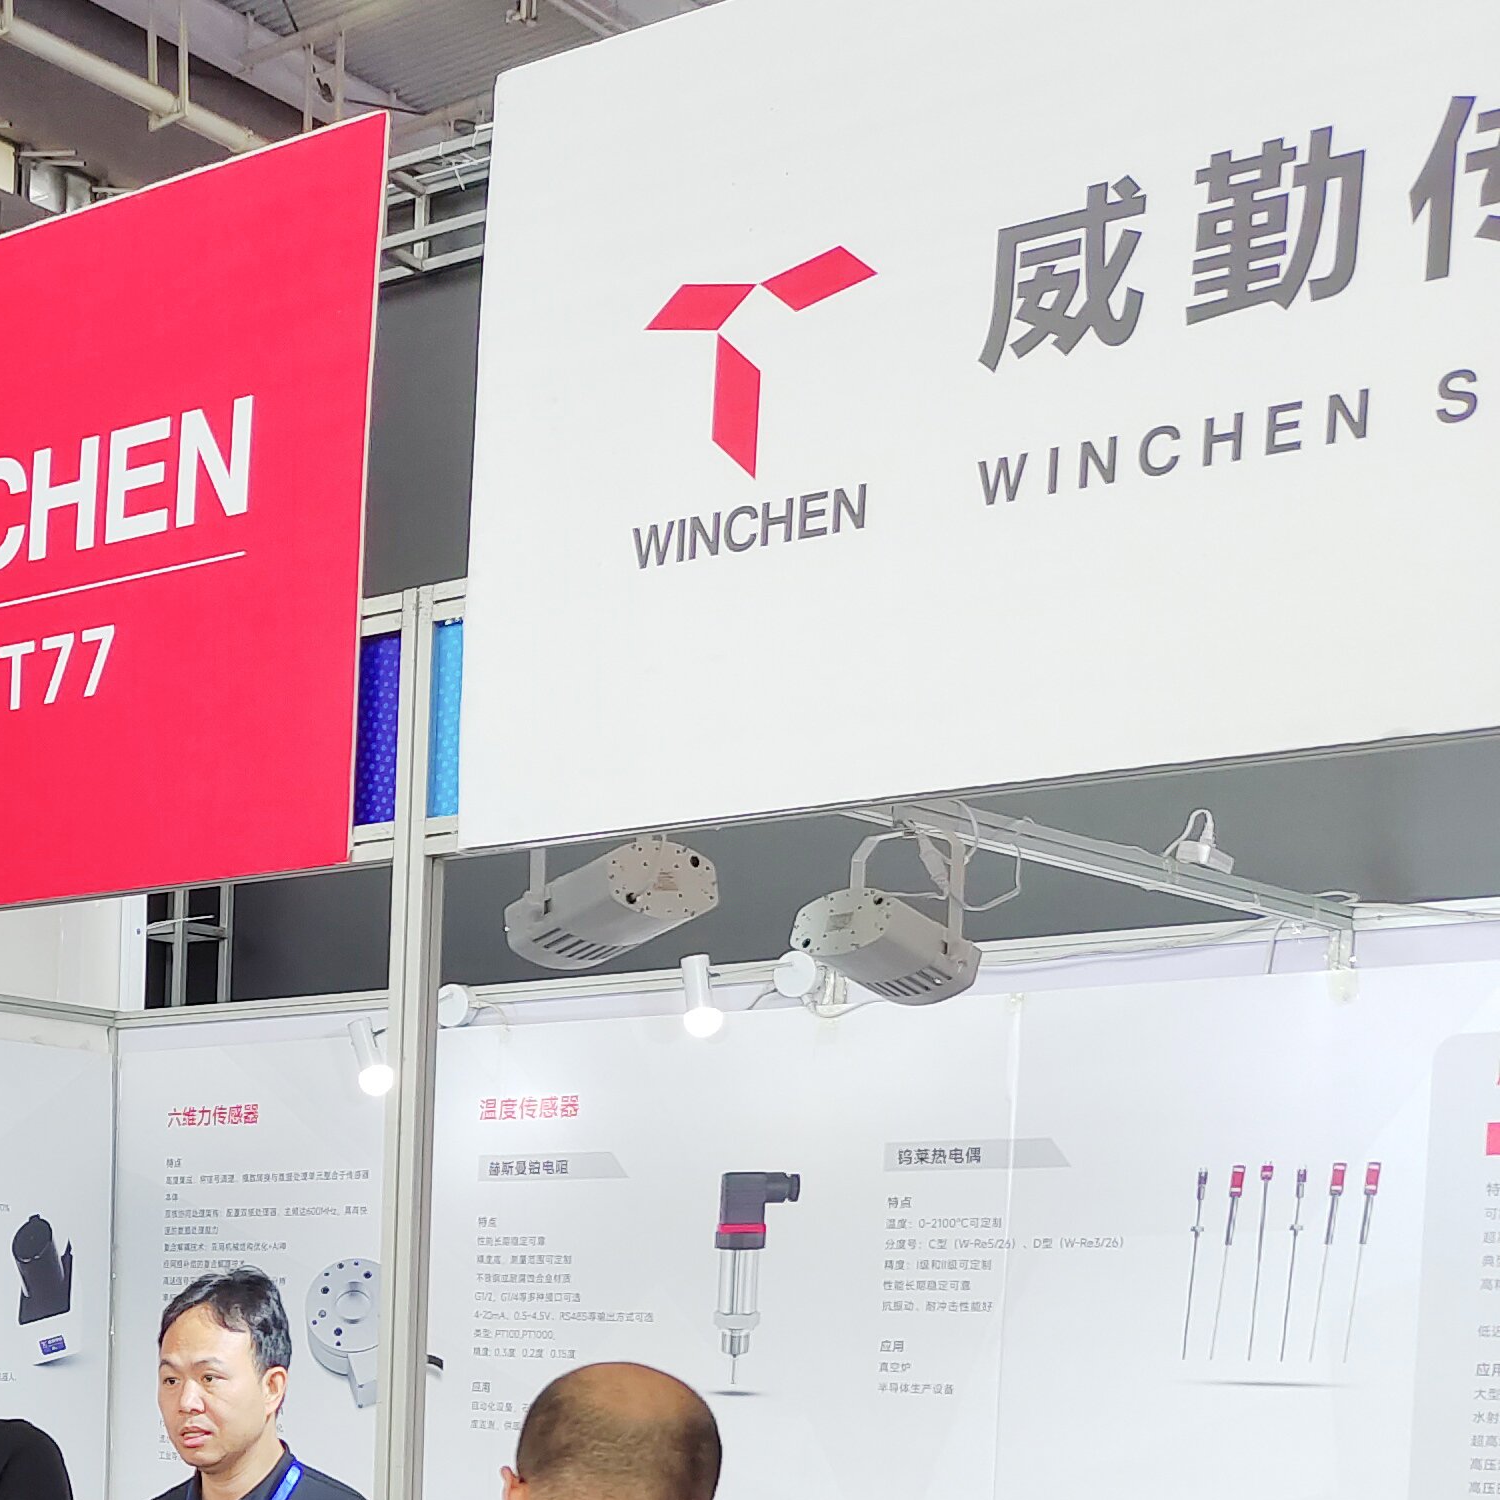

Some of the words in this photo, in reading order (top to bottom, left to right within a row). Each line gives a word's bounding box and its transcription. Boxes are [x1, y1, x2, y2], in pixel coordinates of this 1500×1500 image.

[977, 388, 1371, 507] WINCHEN
[632, 483, 868, 570] WINCHEN
[479, 1094, 580, 1121] 温度传感器
[167, 1103, 259, 1128] 六维力传感器
[887, 1197, 912, 1209] 特点
[478, 1216, 498, 1229] 特点
[880, 1340, 904, 1352] 应用
[879, 1362, 911, 1373] 真空炉
[471, 1381, 491, 1394] 应用
[877, 1382, 955, 1395] 半导体生产设备
